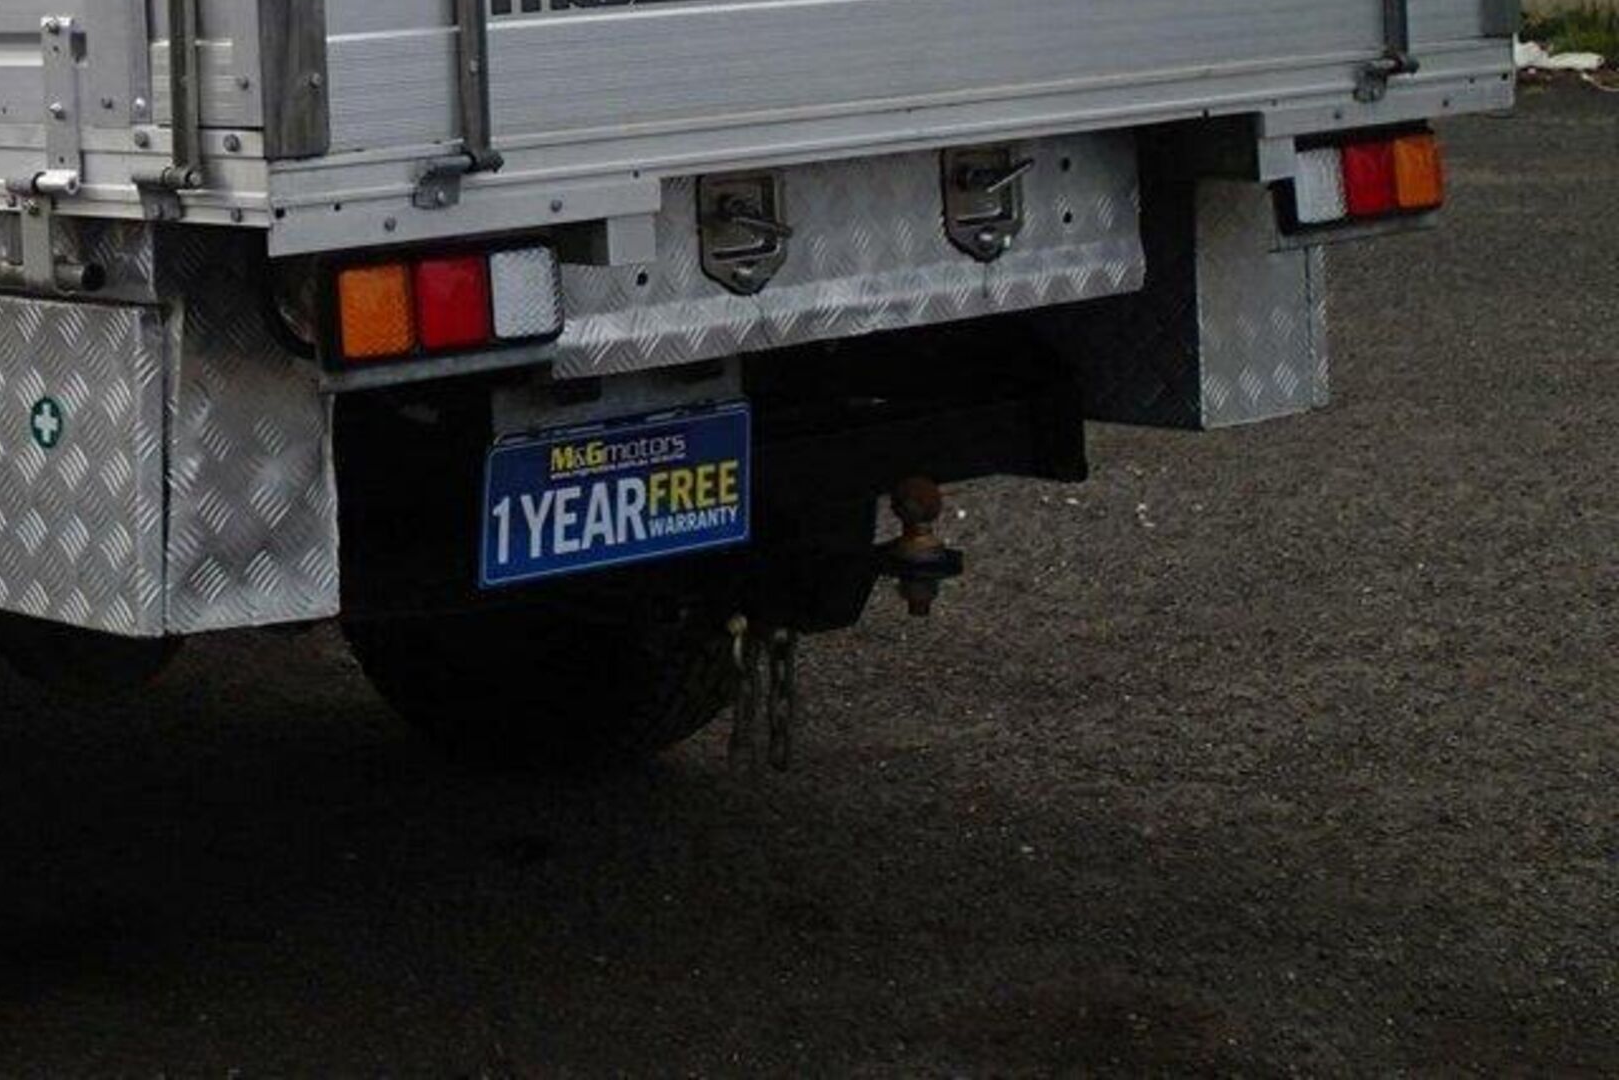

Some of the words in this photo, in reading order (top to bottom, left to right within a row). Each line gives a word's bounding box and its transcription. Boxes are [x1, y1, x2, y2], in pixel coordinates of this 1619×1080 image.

[492, 495, 511, 565] 1
[520, 477, 648, 559] YEAR
[649, 460, 740, 517] FREE
[648, 504, 739, 538] WARRANTY
